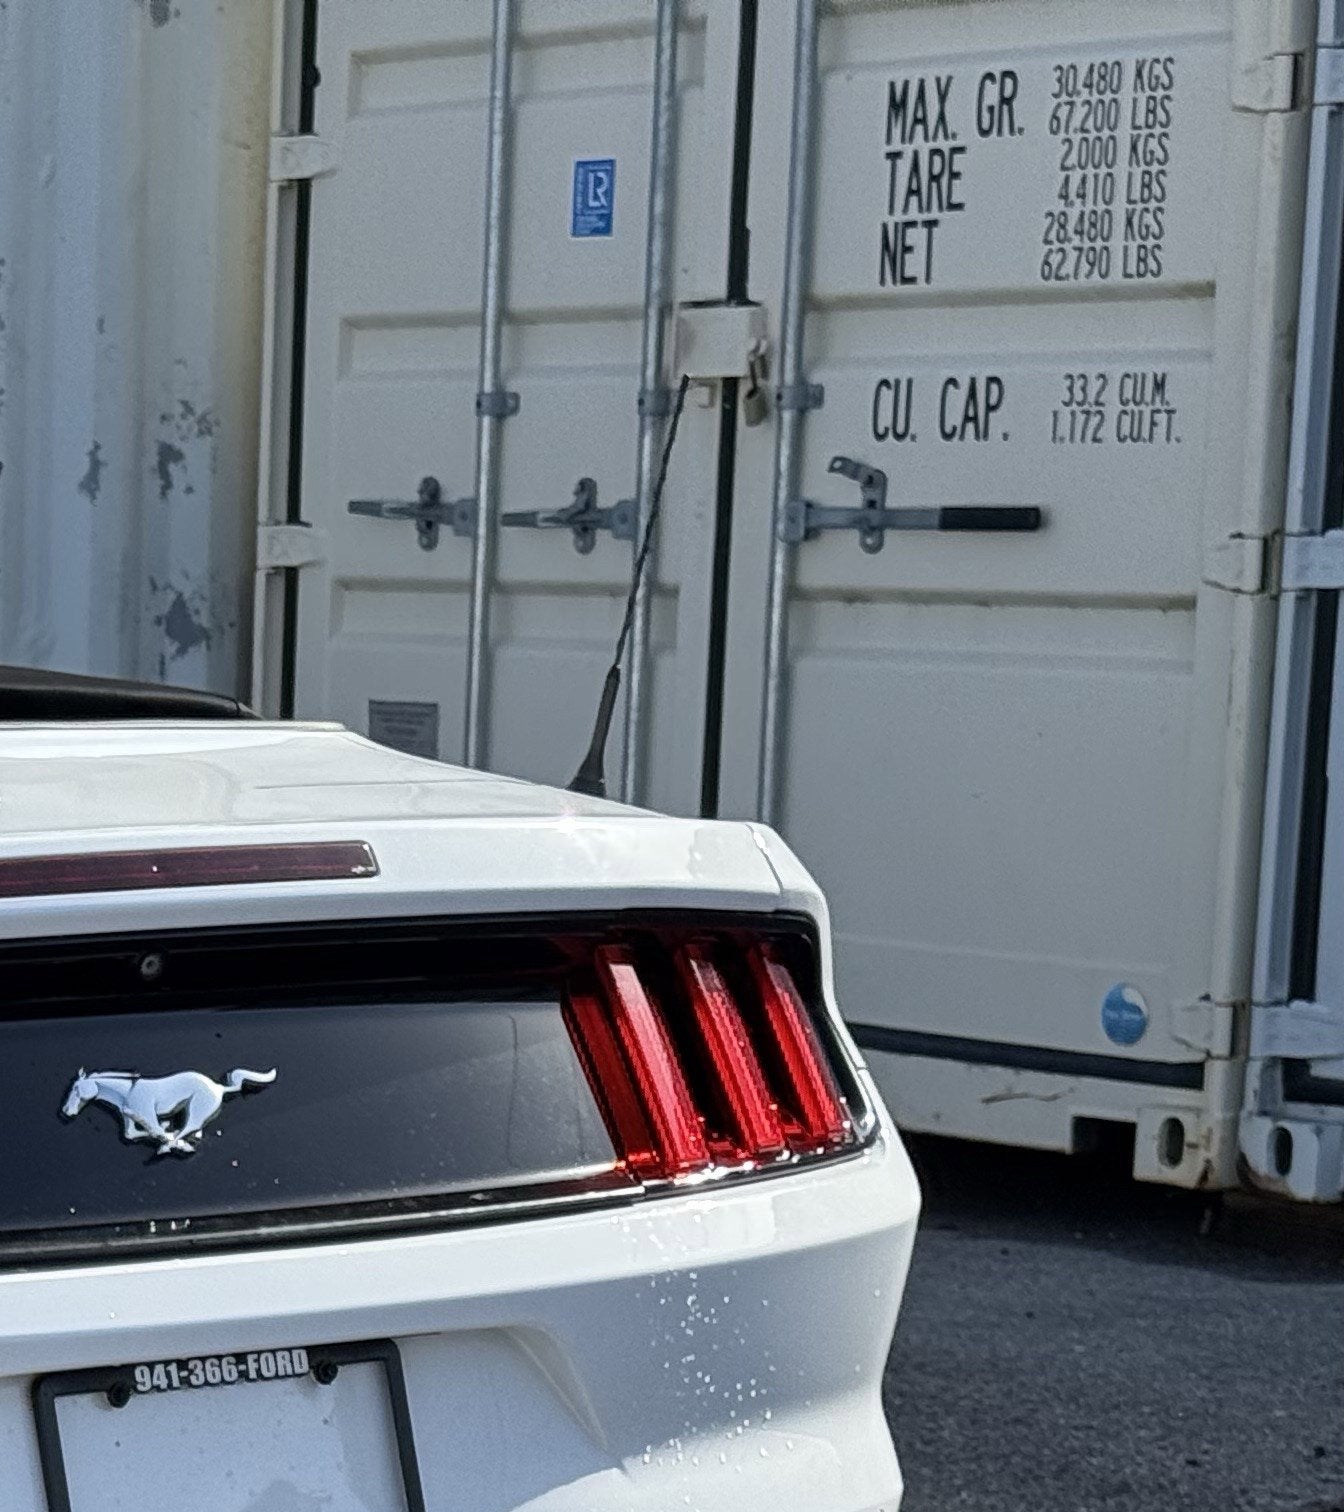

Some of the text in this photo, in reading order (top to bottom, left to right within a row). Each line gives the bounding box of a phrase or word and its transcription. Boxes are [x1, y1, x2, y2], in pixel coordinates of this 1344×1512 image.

[1052, 56, 1175, 99] 30.480 KGS
[885, 70, 1025, 146] MAX. GR.
[1049, 94, 1171, 136] 67.200 LBS
[1060, 132, 1170, 172] 2.000 KGS
[885, 146, 967, 216] TARE
[1058, 169, 1167, 207] 4.410 LBS
[1042, 206, 1165, 246] 28.480 KGS
[879, 218, 940, 287] NET
[1040, 244, 1162, 281] 62.790 LBS
[872, 376, 1010, 442] CU. CAP.
[1061, 371, 1171, 408] 33.2 CU.M.
[1051, 408, 1182, 445] 1.172 CU.FT.
[134, 1347, 310, 1393] 941-366-FORD
